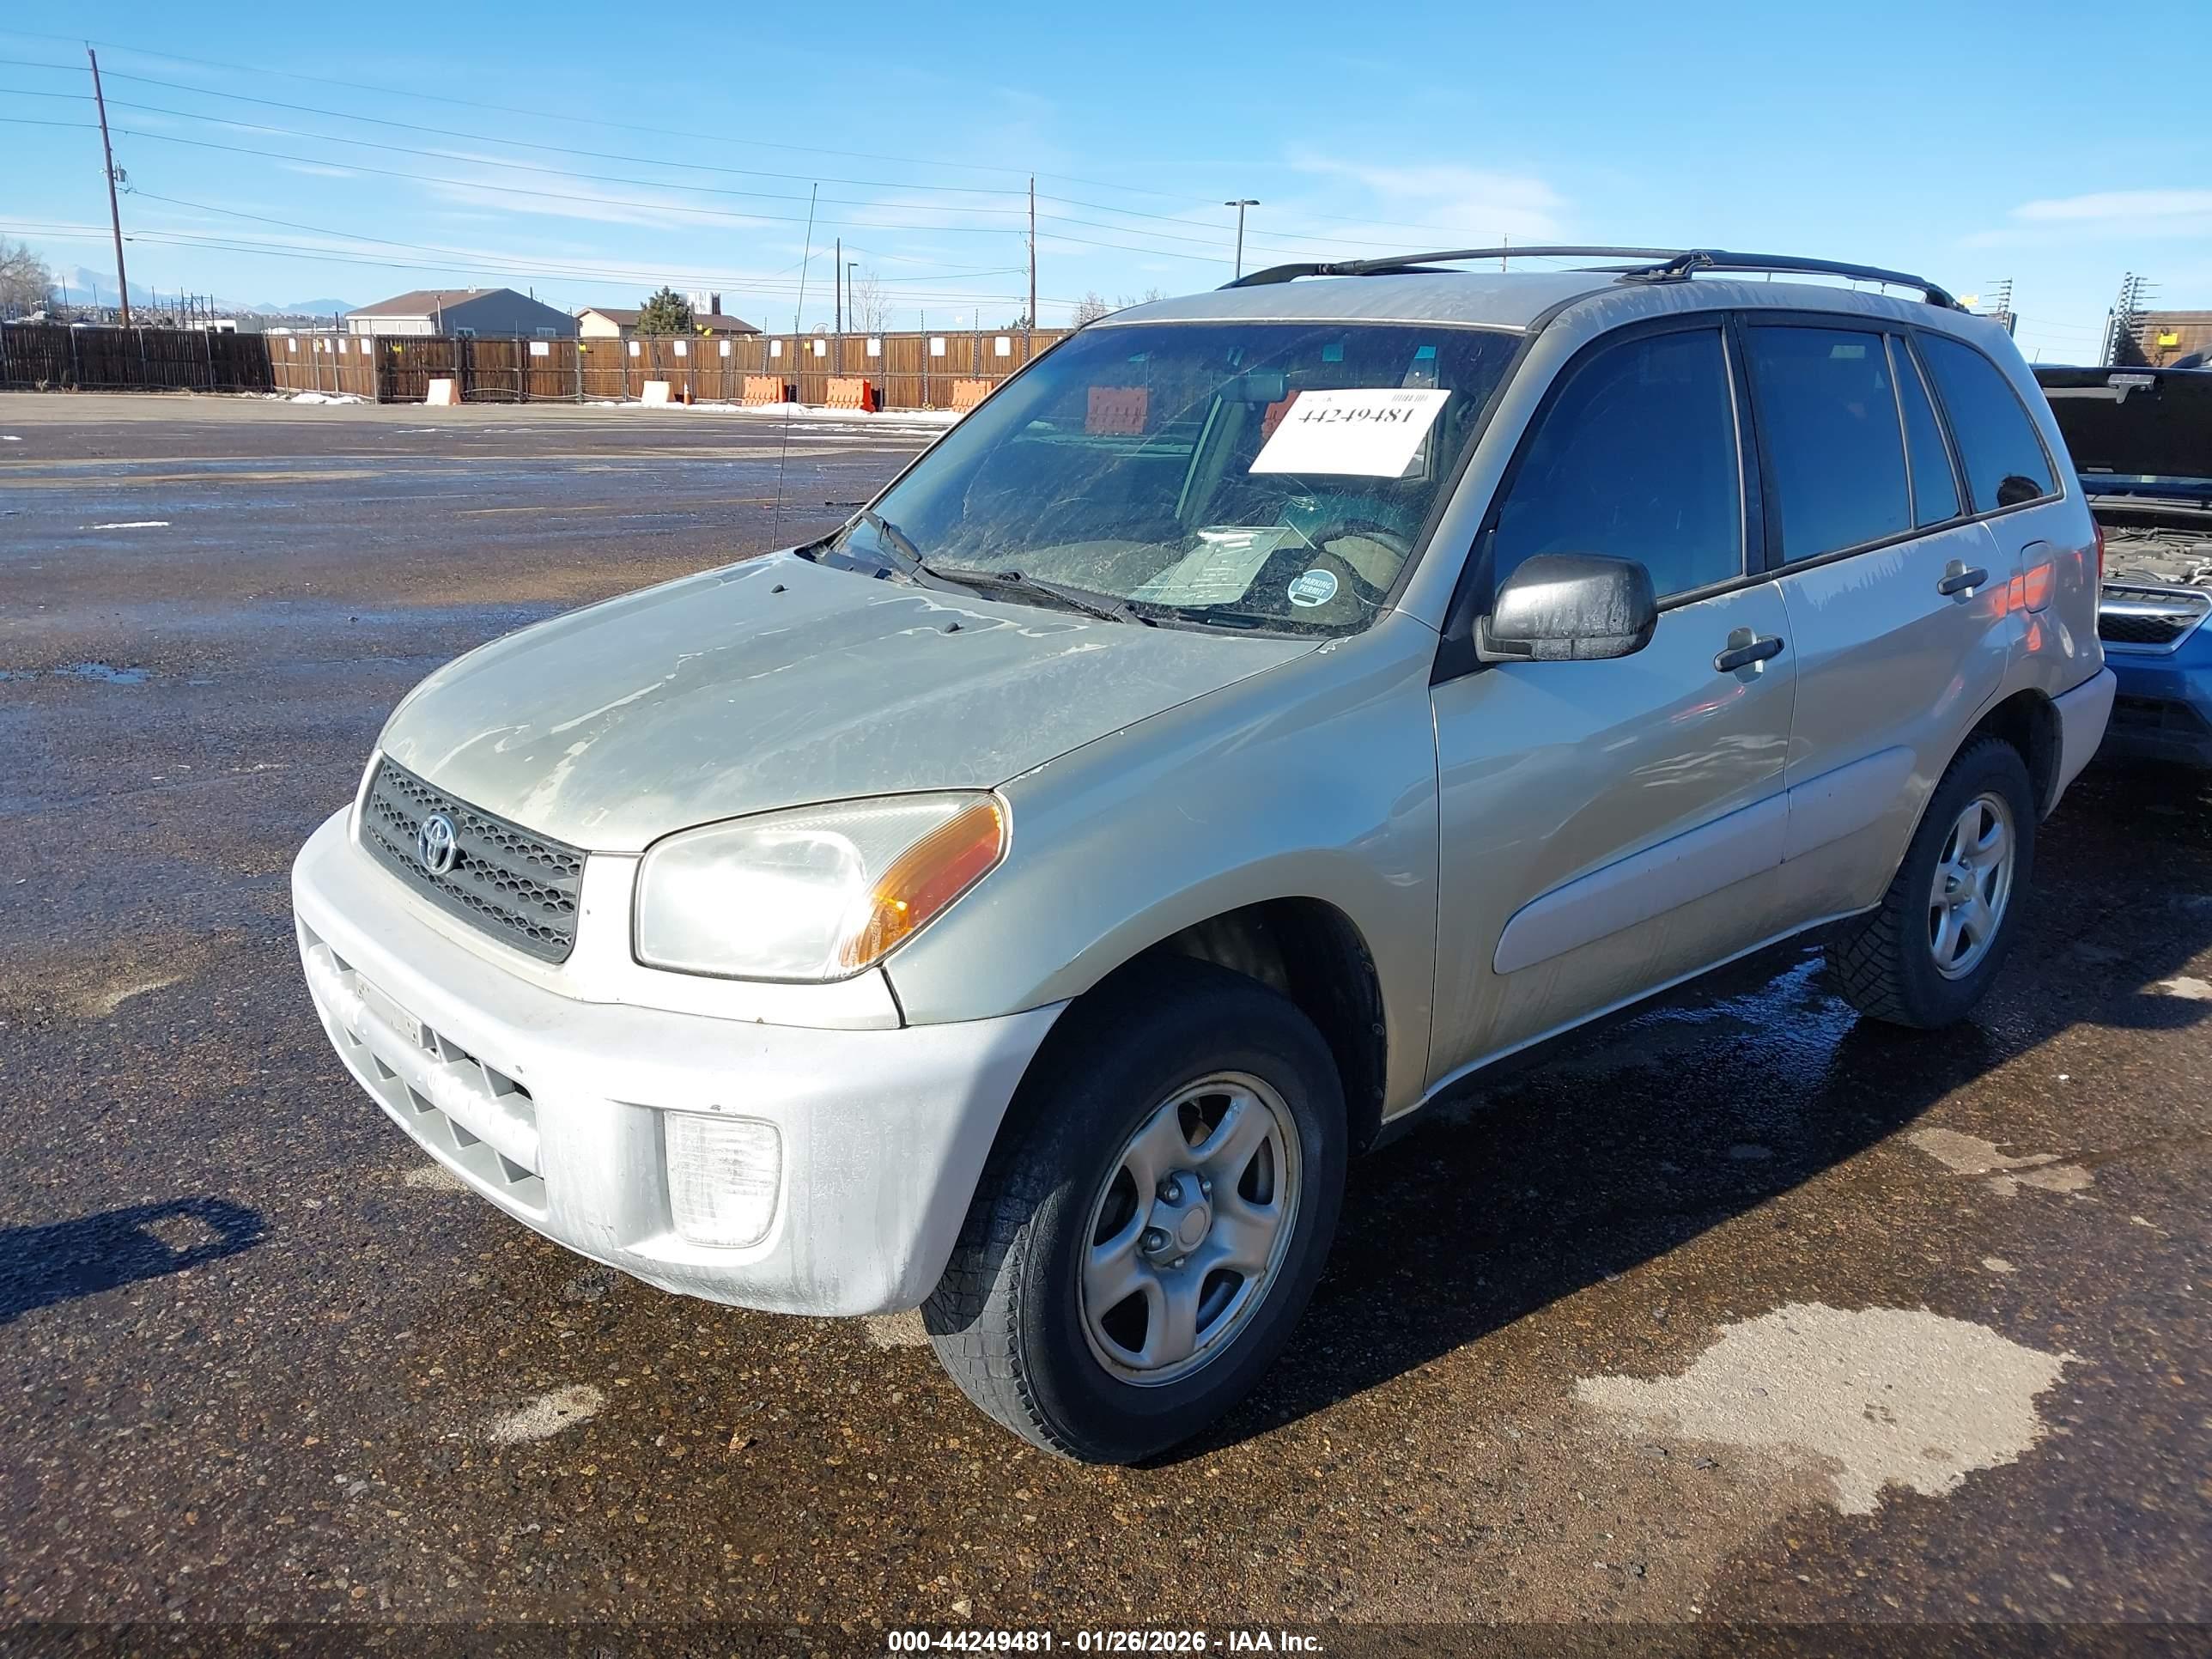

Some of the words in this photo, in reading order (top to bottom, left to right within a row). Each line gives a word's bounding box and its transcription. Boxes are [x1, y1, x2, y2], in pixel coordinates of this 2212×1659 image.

[1298, 408, 1415, 423] 44249481
[1301, 576, 1334, 590] PARKING
[1297, 584, 1327, 597] PERMIT
